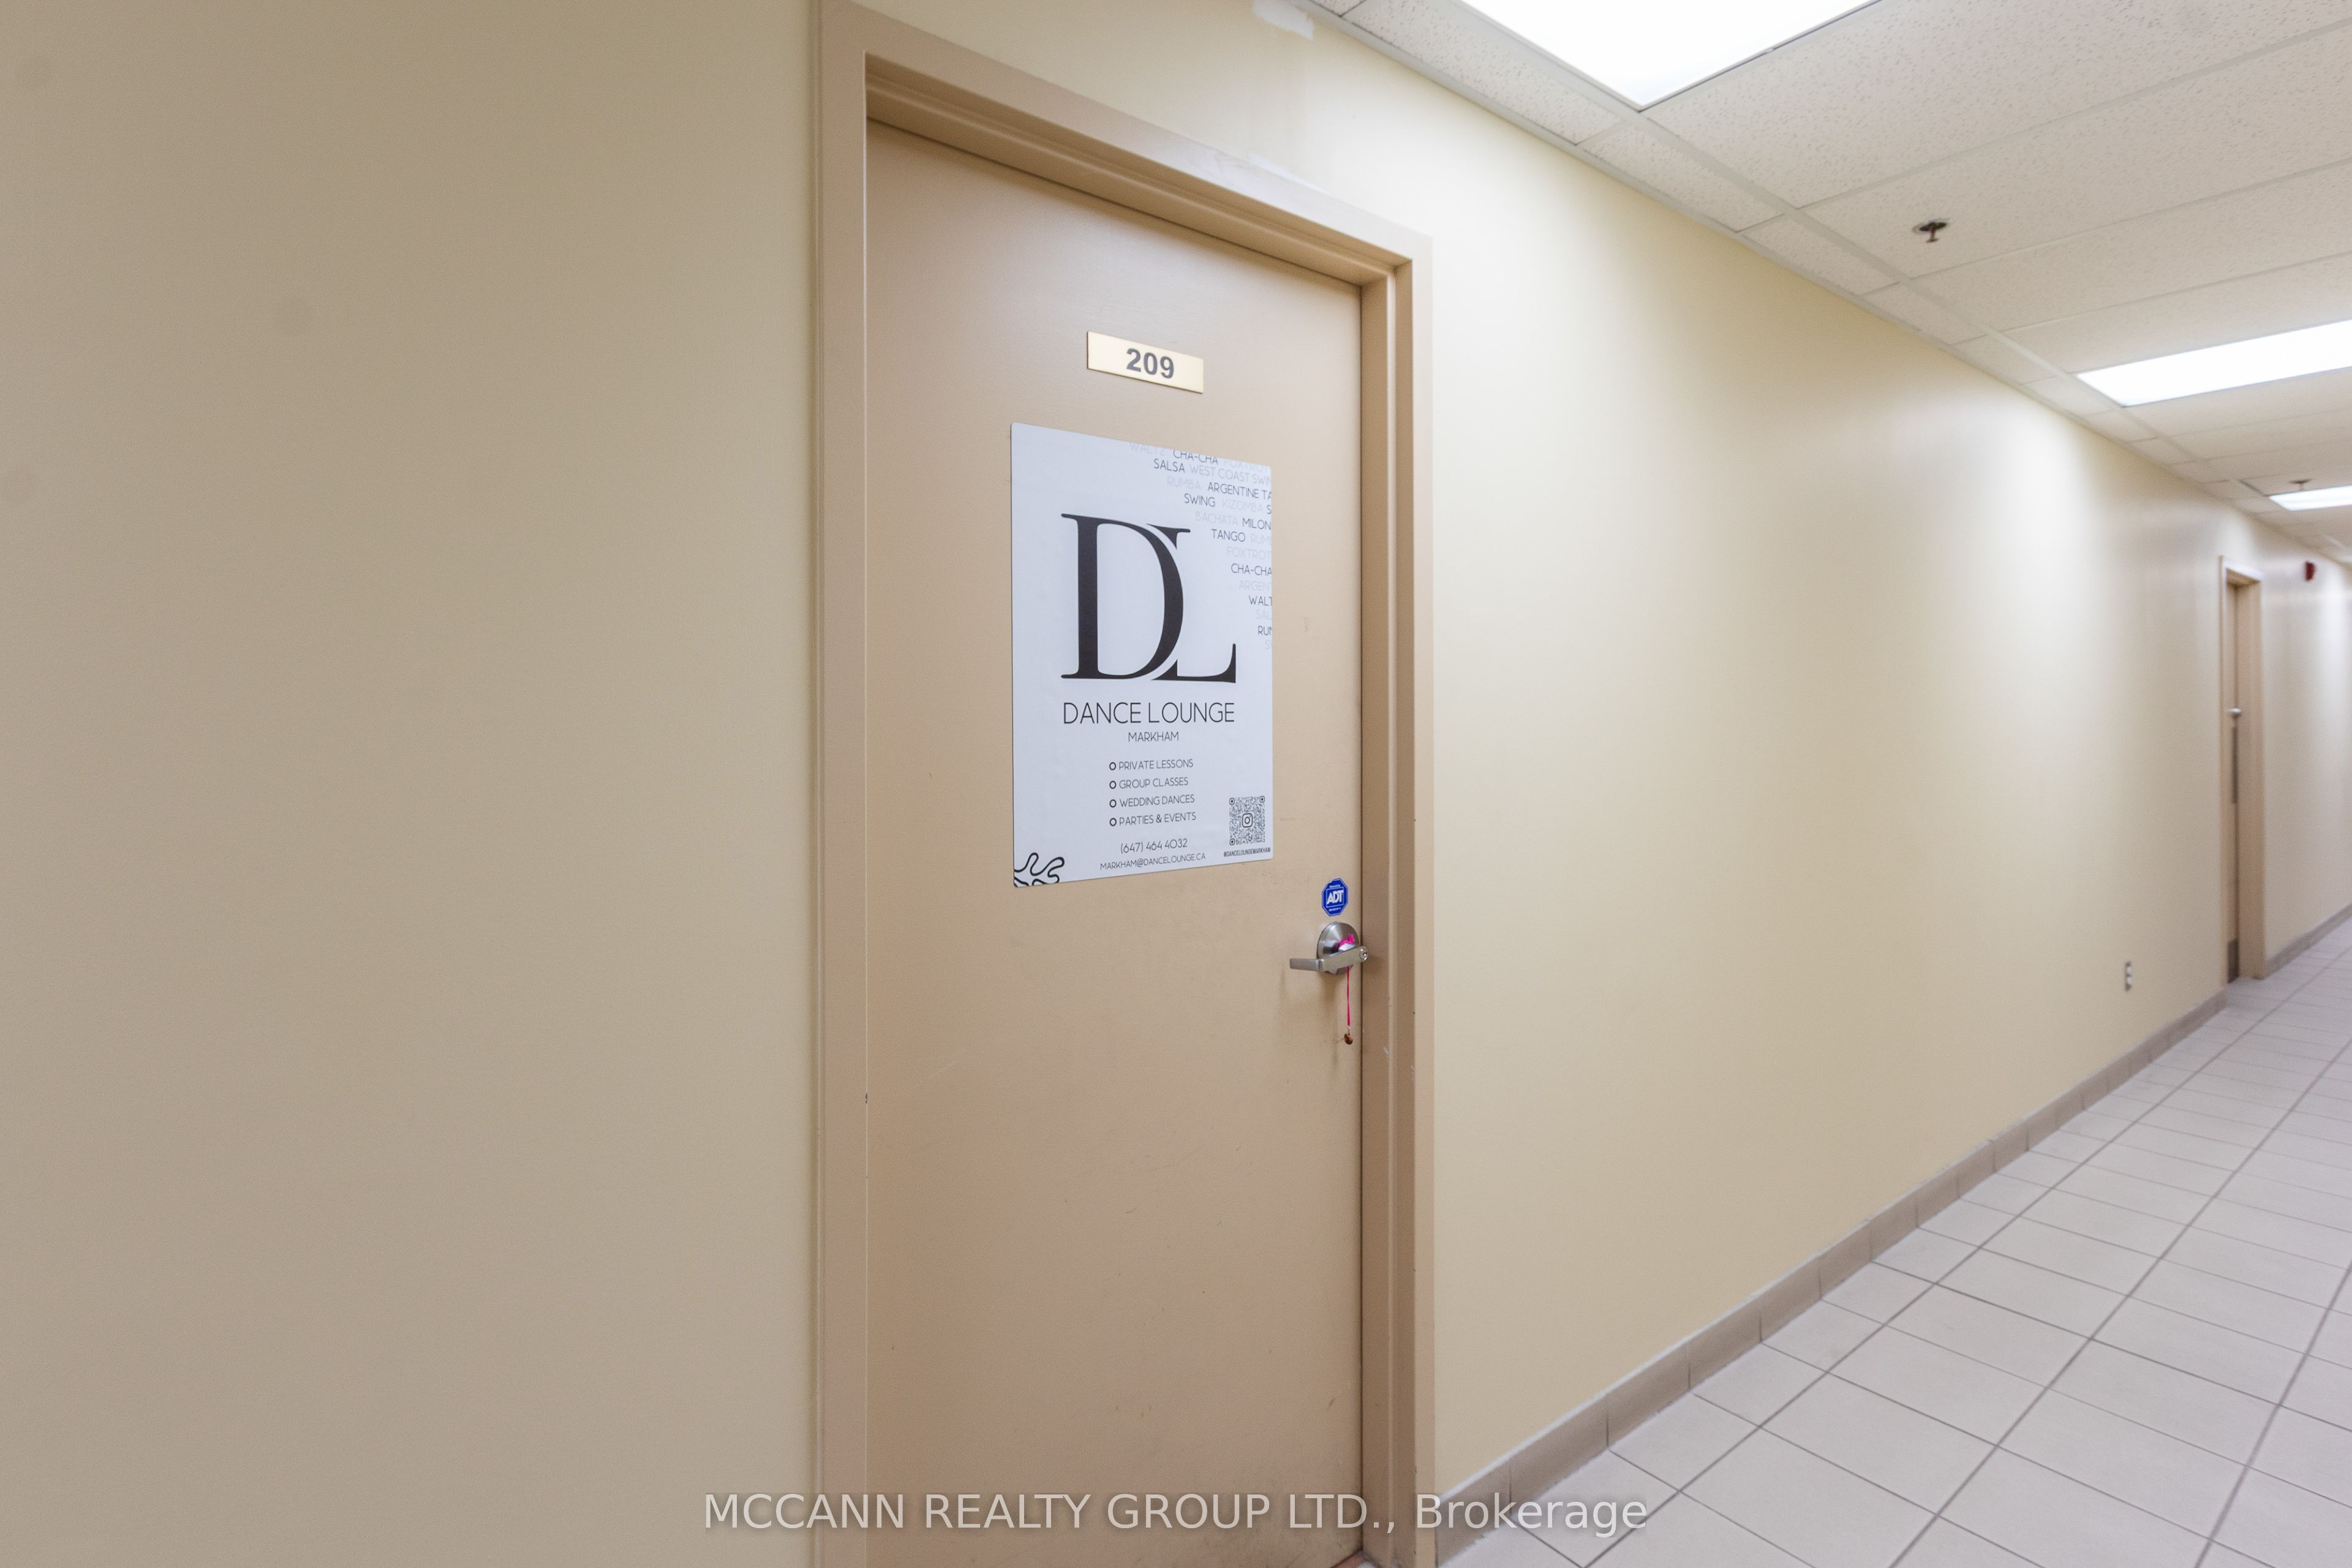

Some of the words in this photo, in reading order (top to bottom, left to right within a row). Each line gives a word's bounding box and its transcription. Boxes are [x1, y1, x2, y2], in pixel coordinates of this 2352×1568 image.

[1126, 347, 1175, 379] 209
[1172, 450, 1218, 464] CHA-CHA
[1153, 458, 1186, 473] SALSA
[1189, 465, 1218, 477] WEST
[1218, 469, 1251, 482] COAST
[1167, 477, 1201, 491] RUMBA
[1207, 482, 1259, 499] ARGENTINE
[1261, 489, 1272, 500] TA
[1184, 493, 1216, 508] SWING
[1222, 499, 1264, 513] KIZOMBA
[1195, 511, 1238, 525] BACHATA
[1242, 518, 1272, 531] MILON
[1212, 529, 1246, 543] TANGO
[1231, 563, 1272, 577] CHA-CHA
[1061, 513, 1236, 684] DL
[1063, 702, 1142, 725] DANCE
[1148, 702, 1235, 723] LOUNGE
[1128, 731, 1180, 743] MARKHAM
[1118, 760, 1155, 771] PRIVATE
[1156, 759, 1194, 769] LESSONS
[1119, 778, 1151, 790] GROUP
[1152, 777, 1189, 788] CLASSES
[1119, 796, 1160, 808] WEDDING
[1161, 794, 1195, 805] DANCES
[1119, 815, 1154, 826] PARTIES
[1156, 814, 1163, 824] &
[1164, 812, 1197, 823] EVENTS
[1120, 841, 1144, 854] (647)
[1145, 840, 1163, 851] 464
[1164, 838, 1188, 849] 4032
[1100, 853, 1206, 871] MARKHAM@DANCELOUNGE.CA
[1326, 889, 1344, 905] ADT
